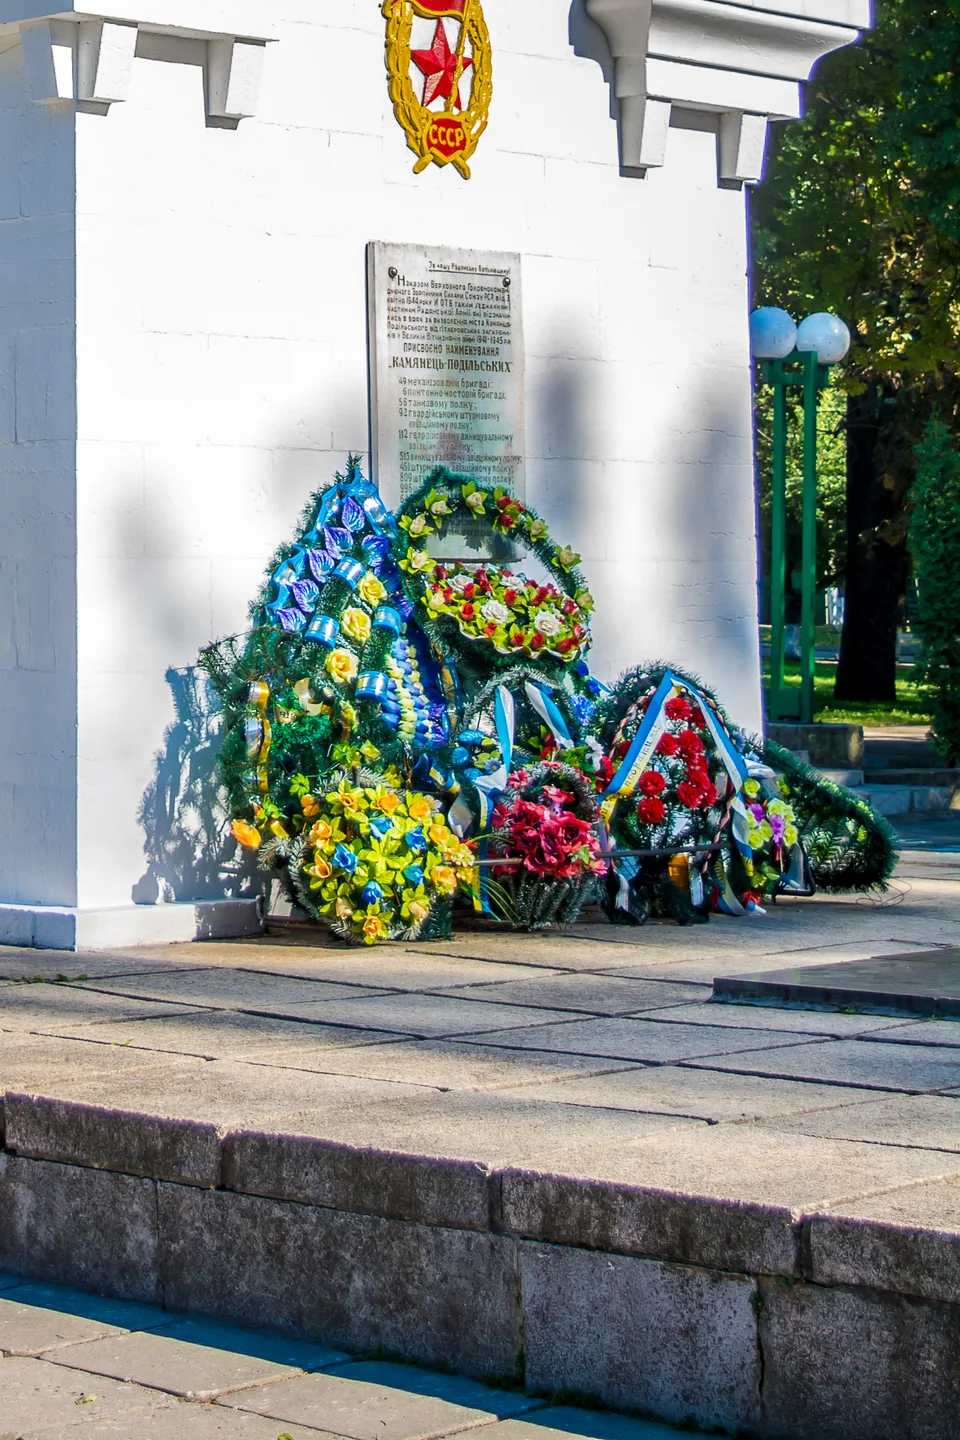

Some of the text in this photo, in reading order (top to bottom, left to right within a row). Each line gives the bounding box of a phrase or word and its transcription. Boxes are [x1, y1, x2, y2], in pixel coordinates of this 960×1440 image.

[428, 124, 465, 148] СССР
[403, 342, 443, 354] ПРИСВОЄНО
[398, 376, 407, 385] 49
[402, 386, 408, 396] 6
[398, 407, 408, 417] 92
[398, 428, 408, 439] 112
[399, 450, 410, 461] 513
